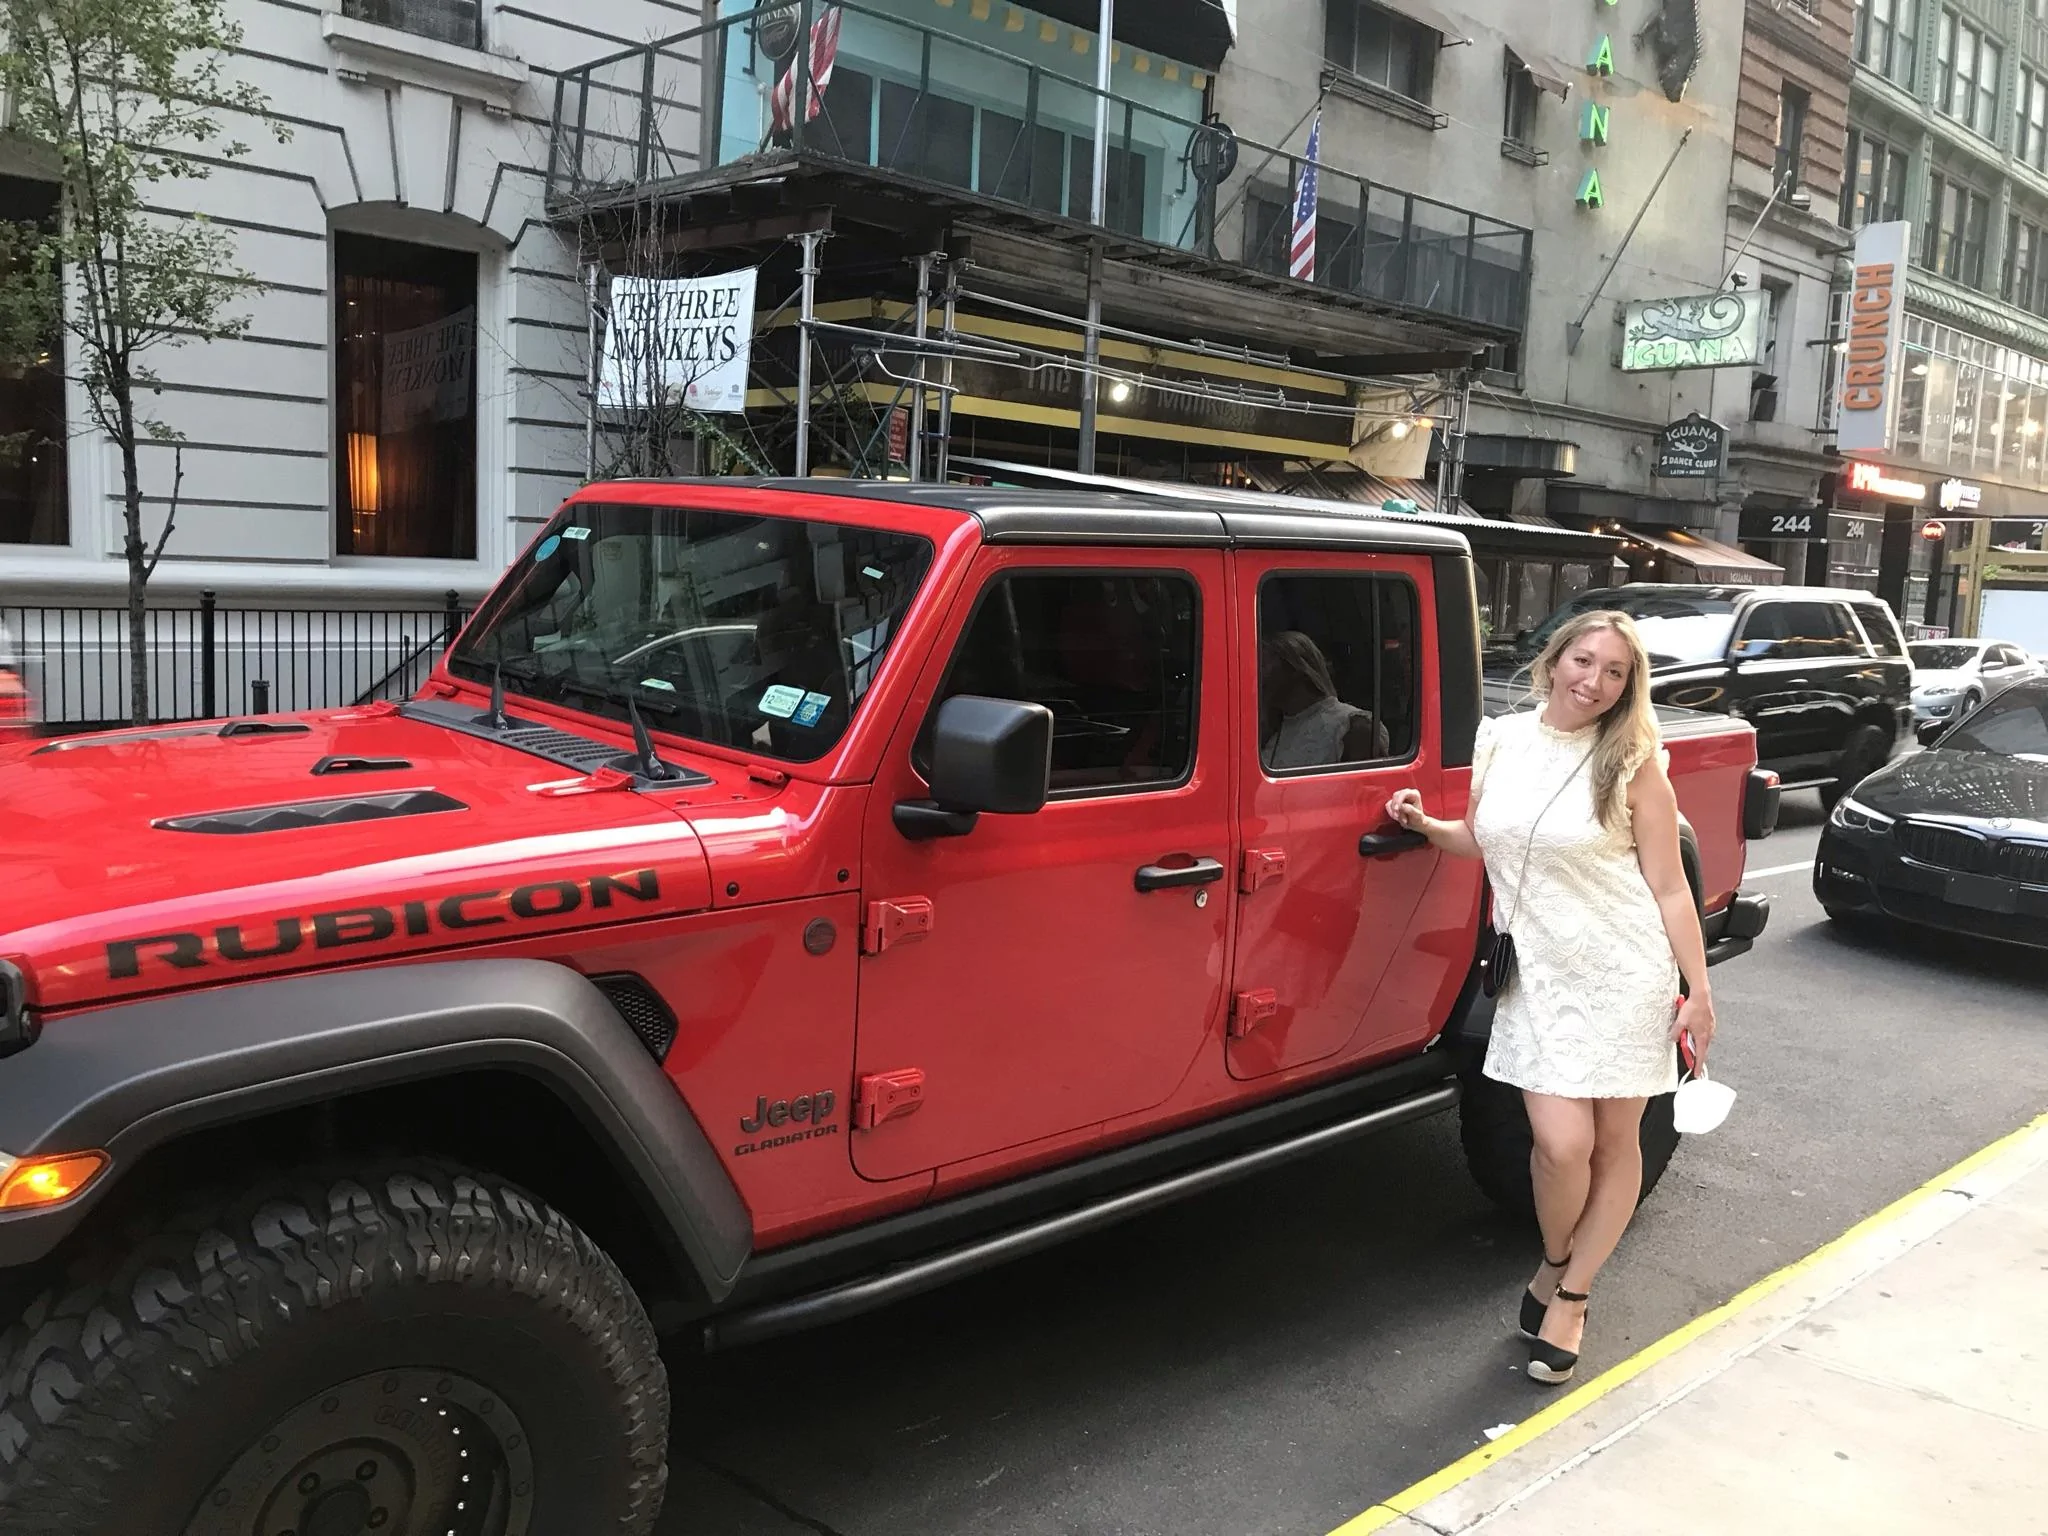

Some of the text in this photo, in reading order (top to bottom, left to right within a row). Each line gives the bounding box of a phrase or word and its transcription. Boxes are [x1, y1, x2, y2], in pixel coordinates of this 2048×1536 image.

[617, 288, 741, 321] THE THREE
[610, 325, 736, 361] MONKEYS
[1626, 336, 1749, 369] IGUANA
[1844, 263, 1894, 411] CRUNCH
[1665, 425, 1718, 442] IGUANA
[1661, 455, 1717, 468] 2 DANCE CLUBS
[1771, 515, 1811, 532] 244
[1846, 520, 1865, 538] 244
[105, 868, 663, 979] RUBICON
[741, 1089, 835, 1133] Jeep
[734, 1124, 838, 1156] GLADIATOR
